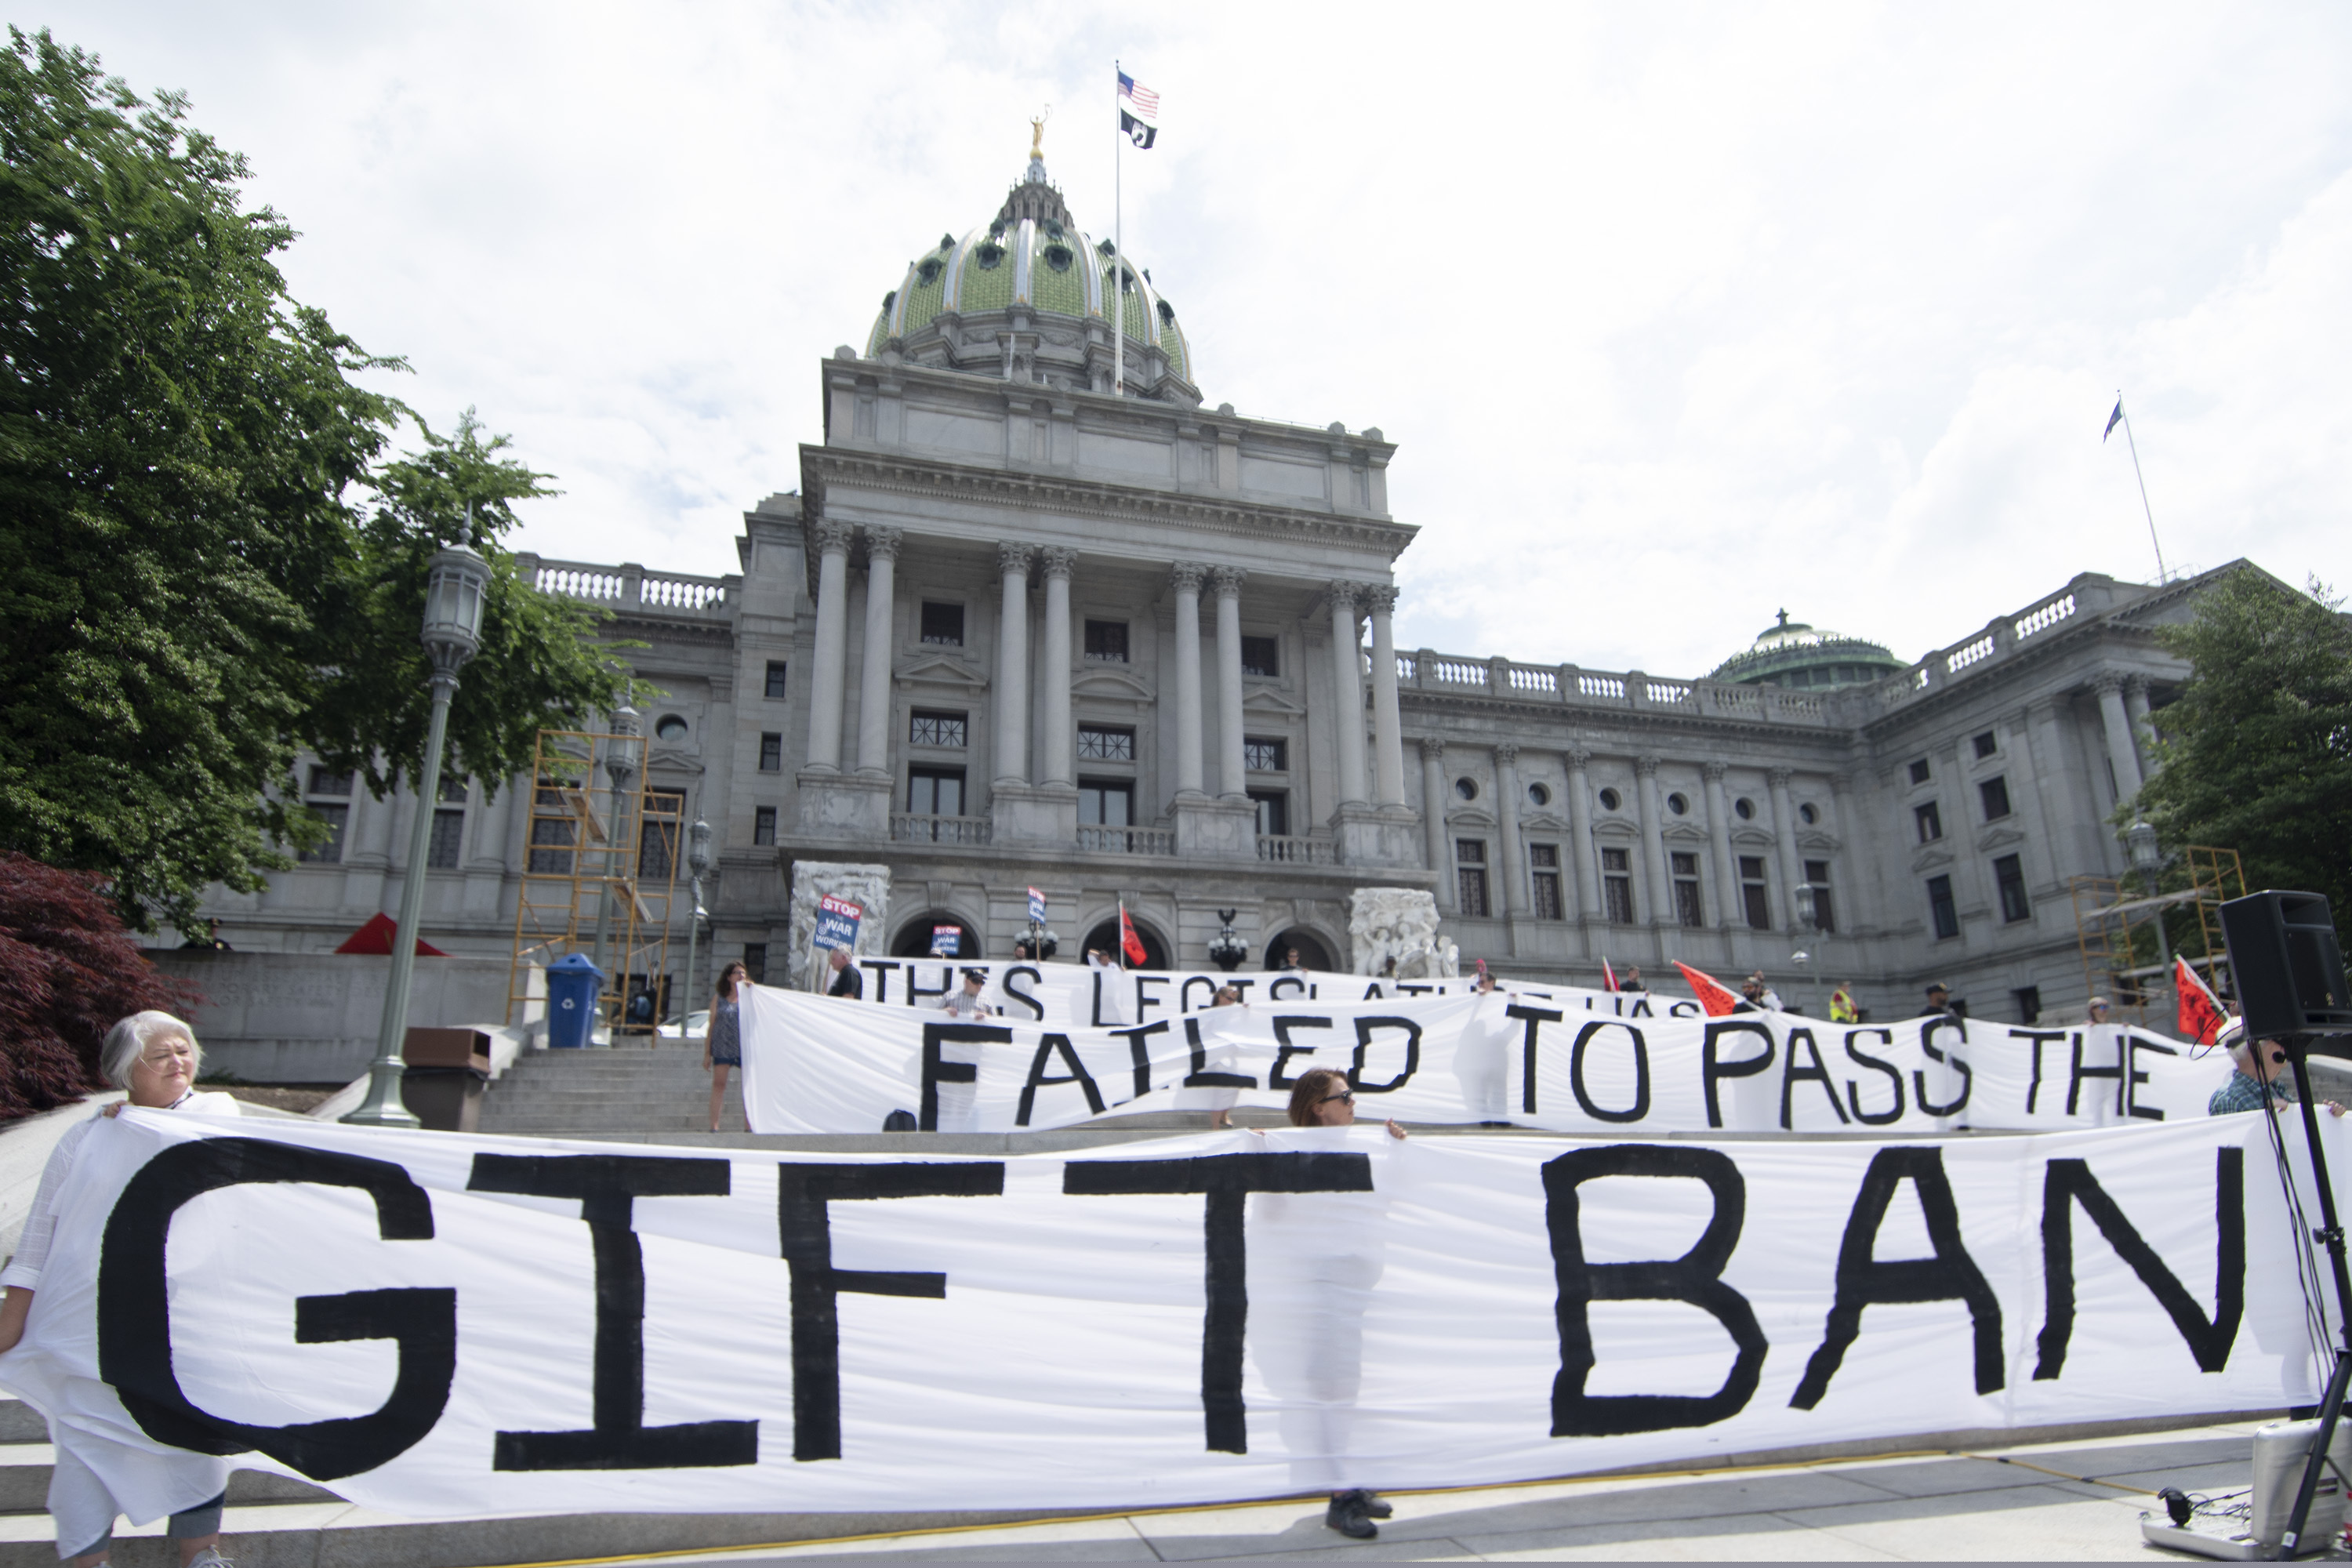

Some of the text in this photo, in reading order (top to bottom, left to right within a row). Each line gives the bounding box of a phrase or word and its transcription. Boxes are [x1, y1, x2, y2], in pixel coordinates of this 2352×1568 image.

[822, 898, 860, 917] STOP
[826, 917, 852, 936] WAR
[920, 1004, 2178, 1131] FAILED TO PASS THE
[97, 1136, 2246, 1482] GIFT BAN
